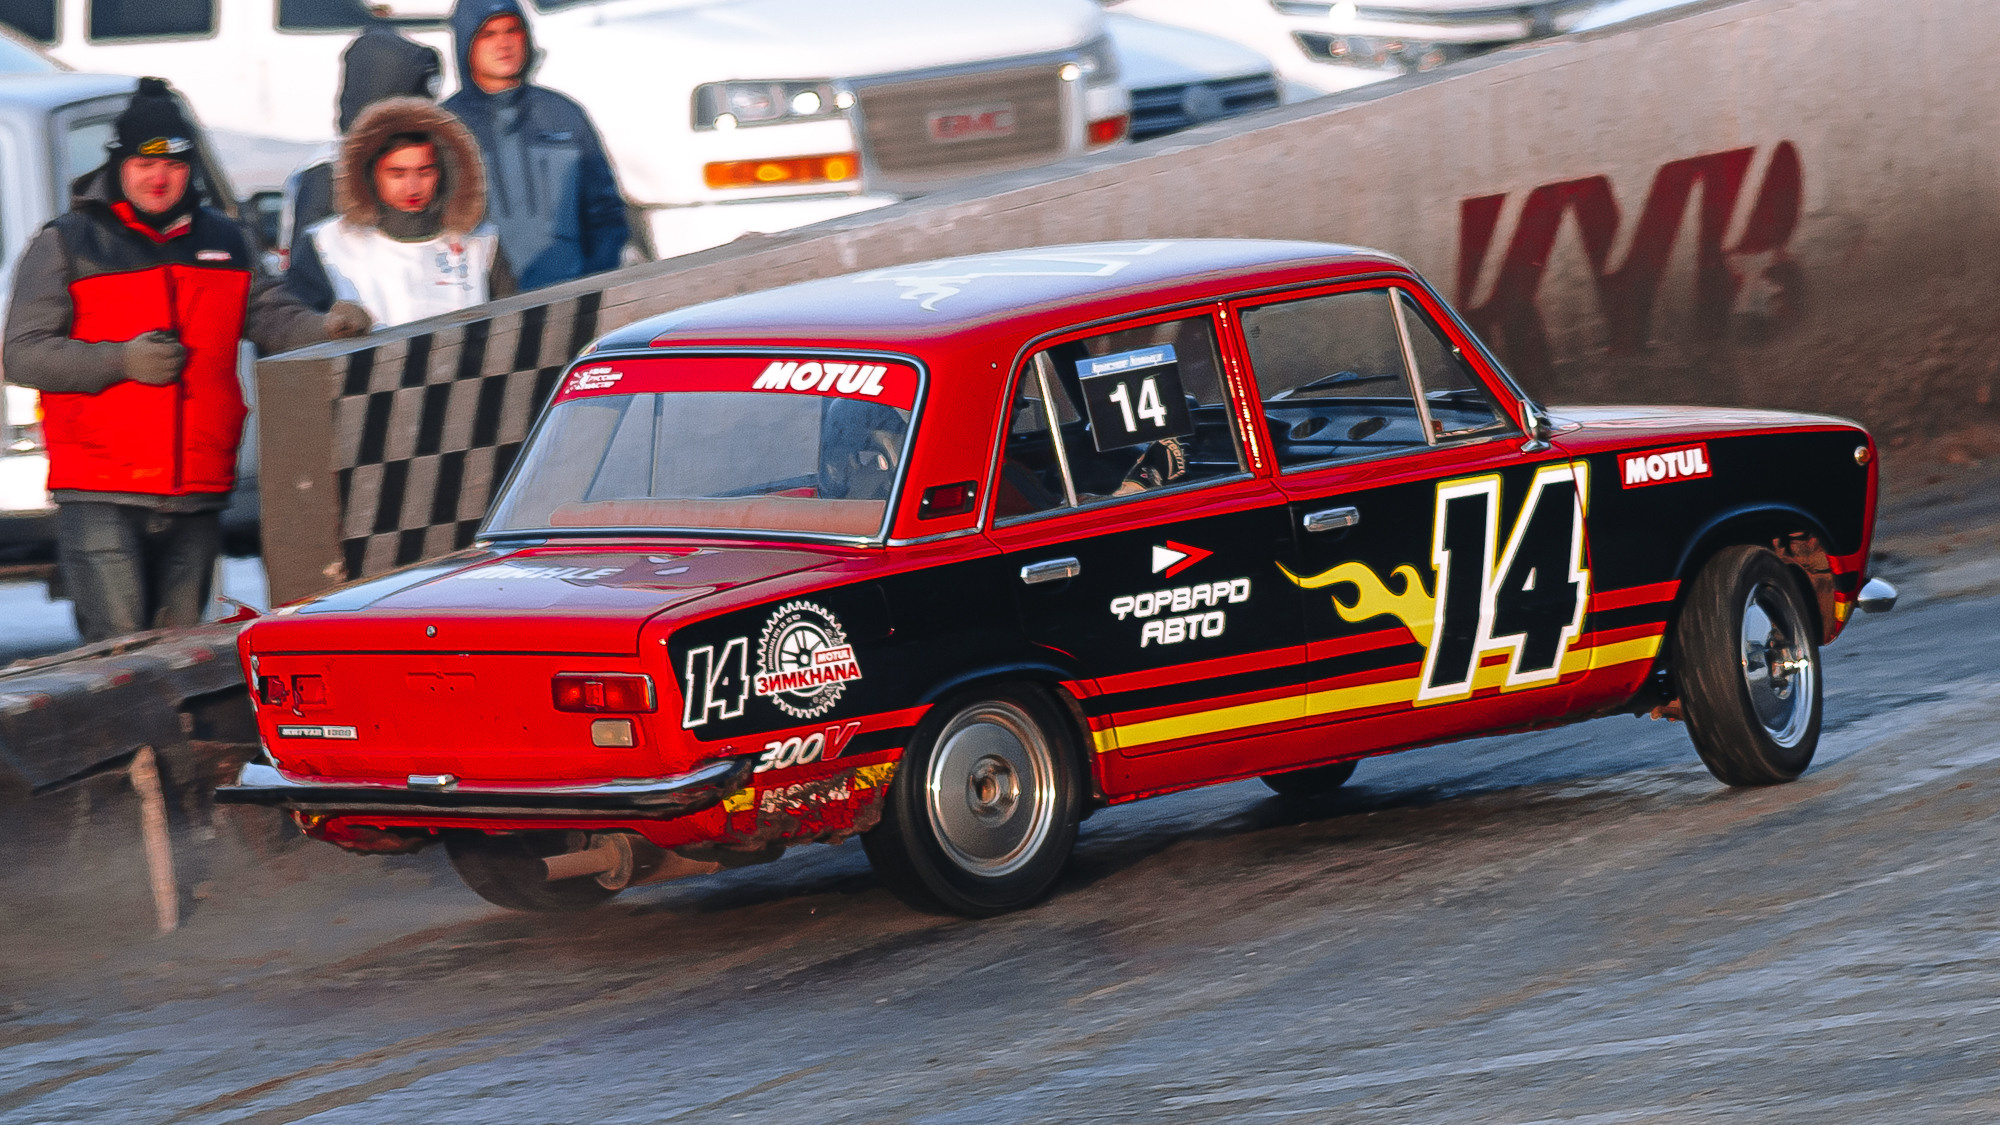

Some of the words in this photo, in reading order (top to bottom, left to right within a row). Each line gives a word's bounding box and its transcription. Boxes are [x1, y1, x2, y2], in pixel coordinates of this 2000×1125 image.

[752, 361, 888, 396] MOTUL
[1109, 376, 1167, 433] 14
[1625, 447, 1709, 485] MOTUL
[1413, 460, 1590, 707] 14
[1140, 610, 1226, 648] АВТО
[817, 649, 849, 663] MOTUL
[683, 637, 750, 729] 14
[753, 721, 862, 774] 300V
